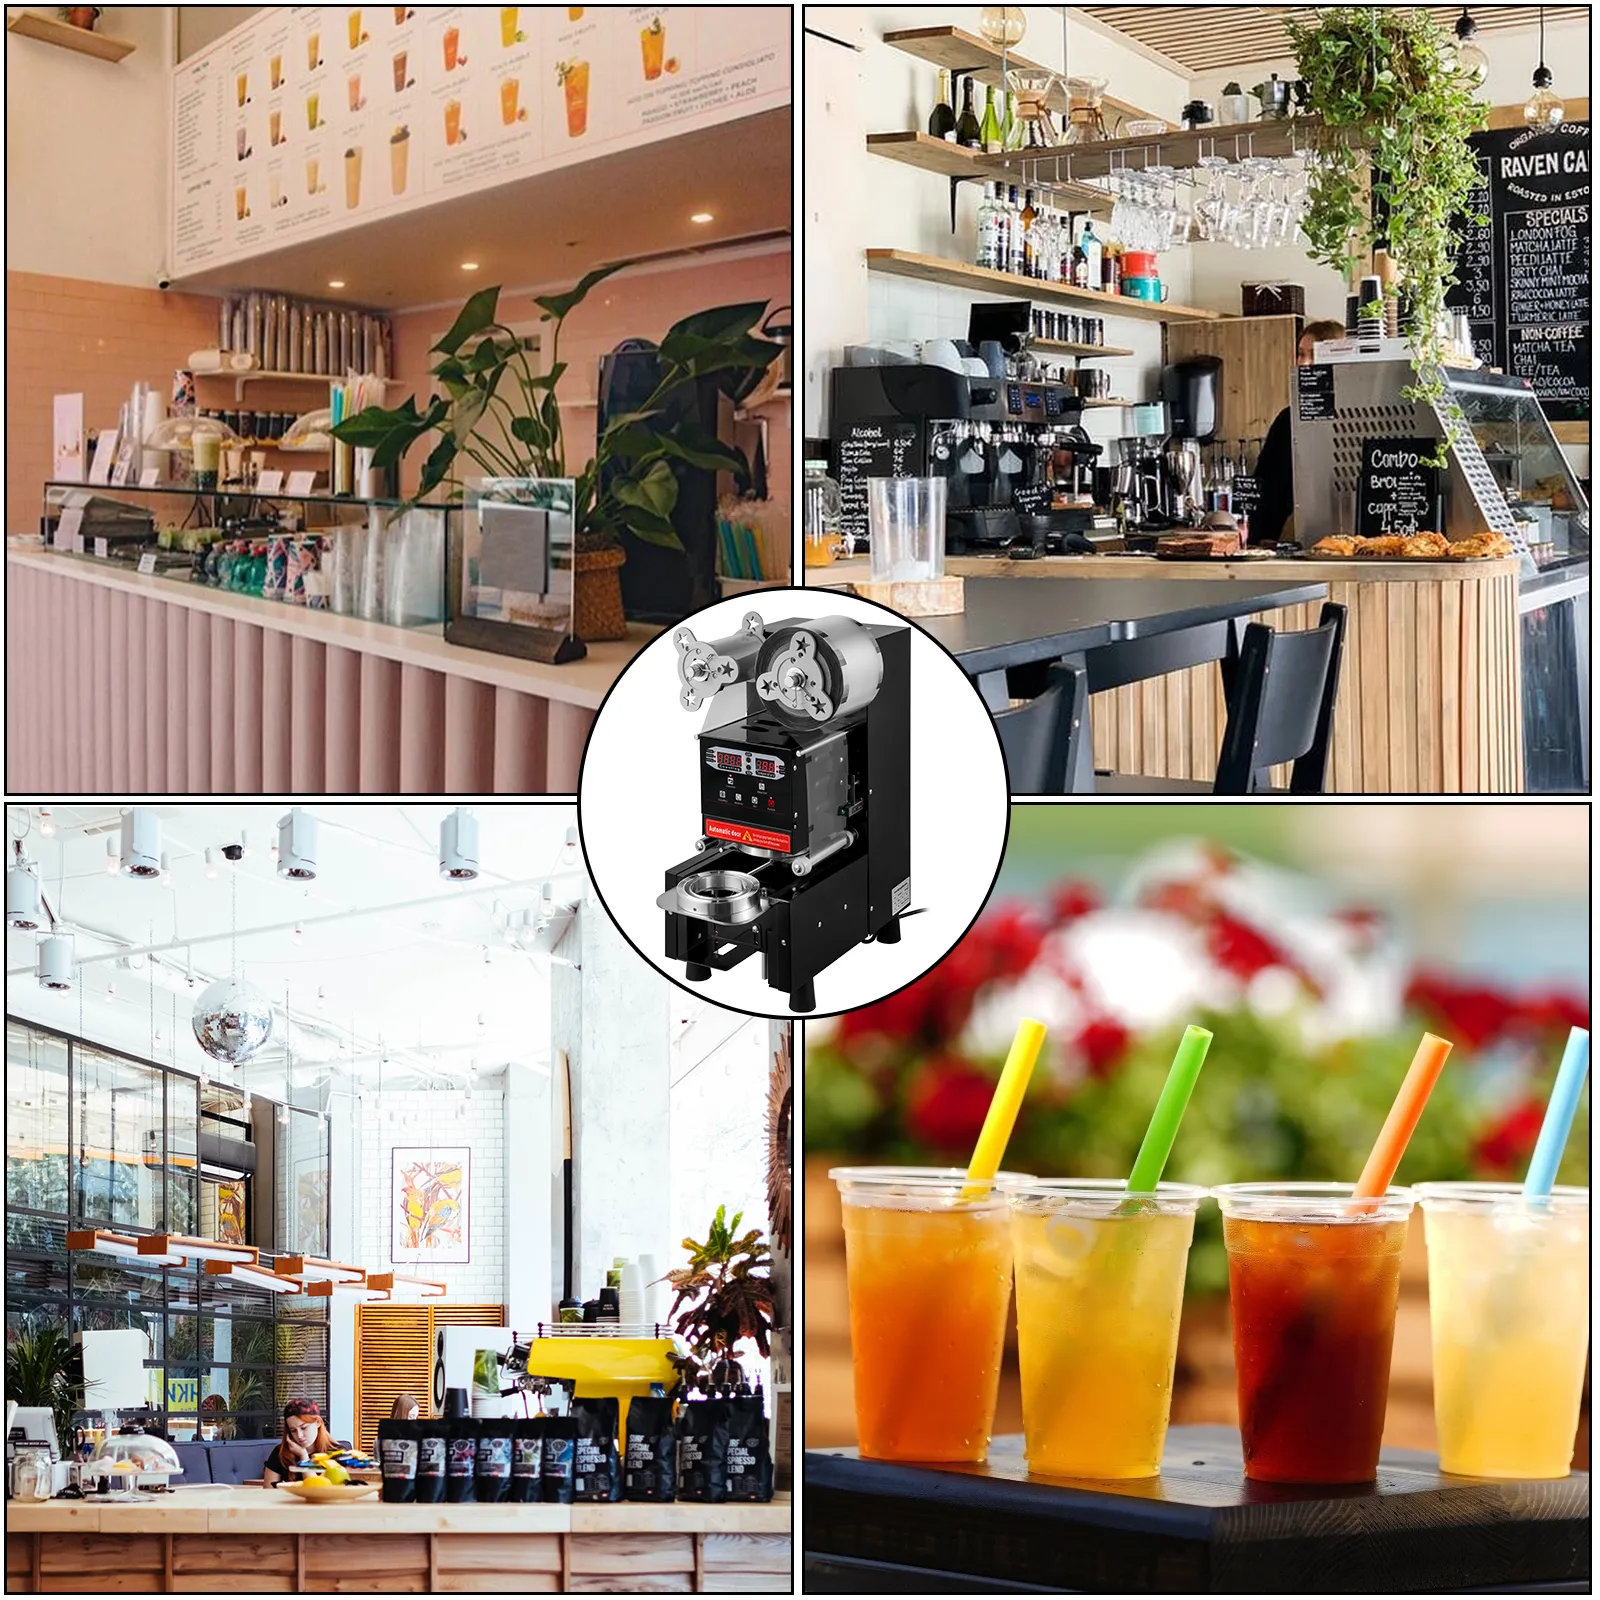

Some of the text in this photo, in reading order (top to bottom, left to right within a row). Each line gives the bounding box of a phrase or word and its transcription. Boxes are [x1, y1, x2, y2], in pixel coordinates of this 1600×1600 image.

[1501, 149, 1590, 179] RAVEN CA
[1507, 182, 1590, 202] ROASTED IN ESTO
[1525, 207, 1589, 228] SPECIALS
[1509, 224, 1577, 242] LONDON FOG
[1509, 238, 1579, 254] MATCHA LATTE
[1541, 251, 1574, 265] LATTE
[1473, 268, 1482, 279] 3
[1510, 265, 1563, 277] DIRTY CHAI
[1473, 293, 1482, 304] 6
[1521, 325, 1584, 341] NON-COFFEE
[1513, 340, 1576, 353] MATCHA TEA
[1514, 354, 1537, 366] CHAI
[1371, 449, 1418, 469] Combo
[708, 825, 742, 838] Automatic door
[577, 1446, 600, 1455] SPECIAL
[628, 1443, 650, 1451] SPECIAL
[576, 1454, 607, 1463] ESPRESSO
[627, 1451, 654, 1460] ESPRESSO
[576, 1463, 596, 1472] BLEND
